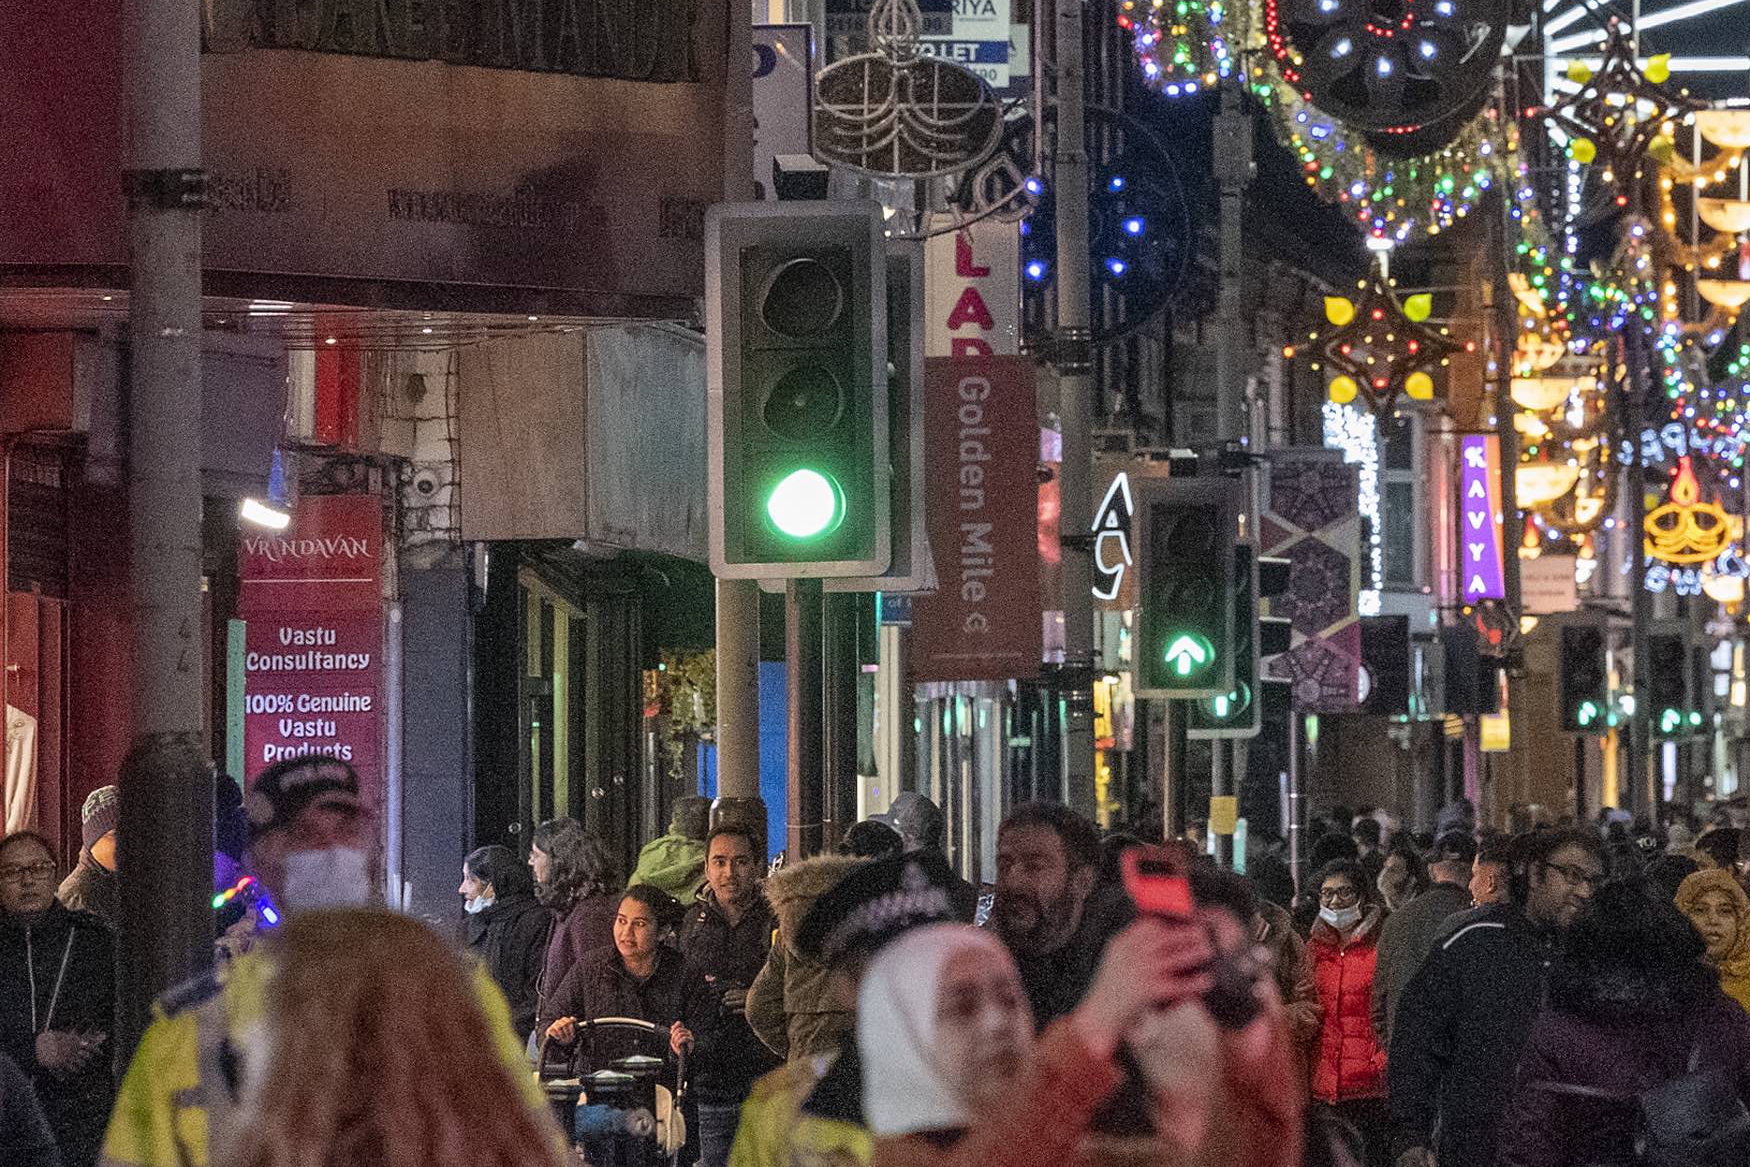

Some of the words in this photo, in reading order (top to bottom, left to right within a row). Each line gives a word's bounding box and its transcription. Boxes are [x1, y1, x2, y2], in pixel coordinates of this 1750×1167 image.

[958, 376, 992, 510] Golden
[1463, 445, 1487, 595] KAVYA
[961, 522, 994, 603] Mile
[279, 627, 336, 646] Vastu
[246, 651, 370, 671] Consultancy
[245, 694, 293, 714] 100%
[297, 692, 372, 713] Genuine
[279, 719, 336, 738] Vastu
[264, 742, 352, 763] Products
